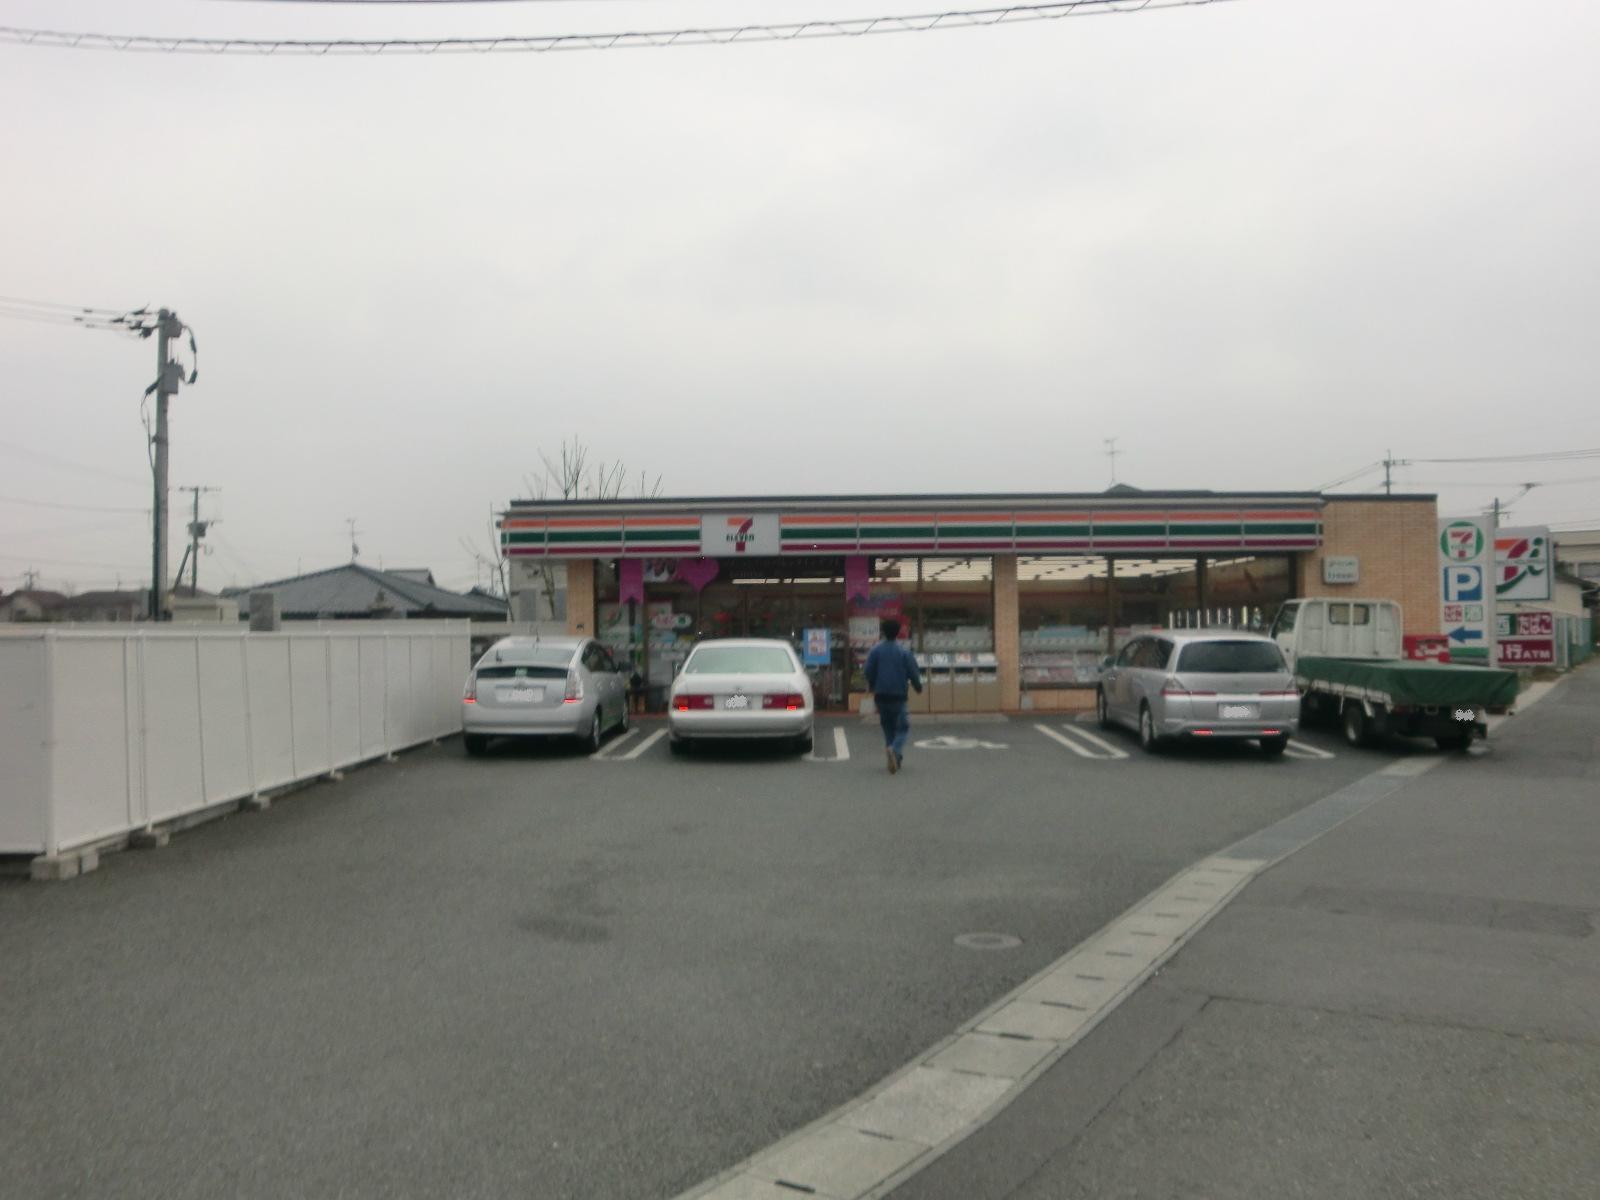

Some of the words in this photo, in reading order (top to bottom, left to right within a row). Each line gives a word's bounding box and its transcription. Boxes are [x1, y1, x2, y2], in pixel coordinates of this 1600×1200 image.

[727, 516, 754, 552] 7
[1451, 531, 1473, 557] 7
[1448, 567, 1479, 601] P
